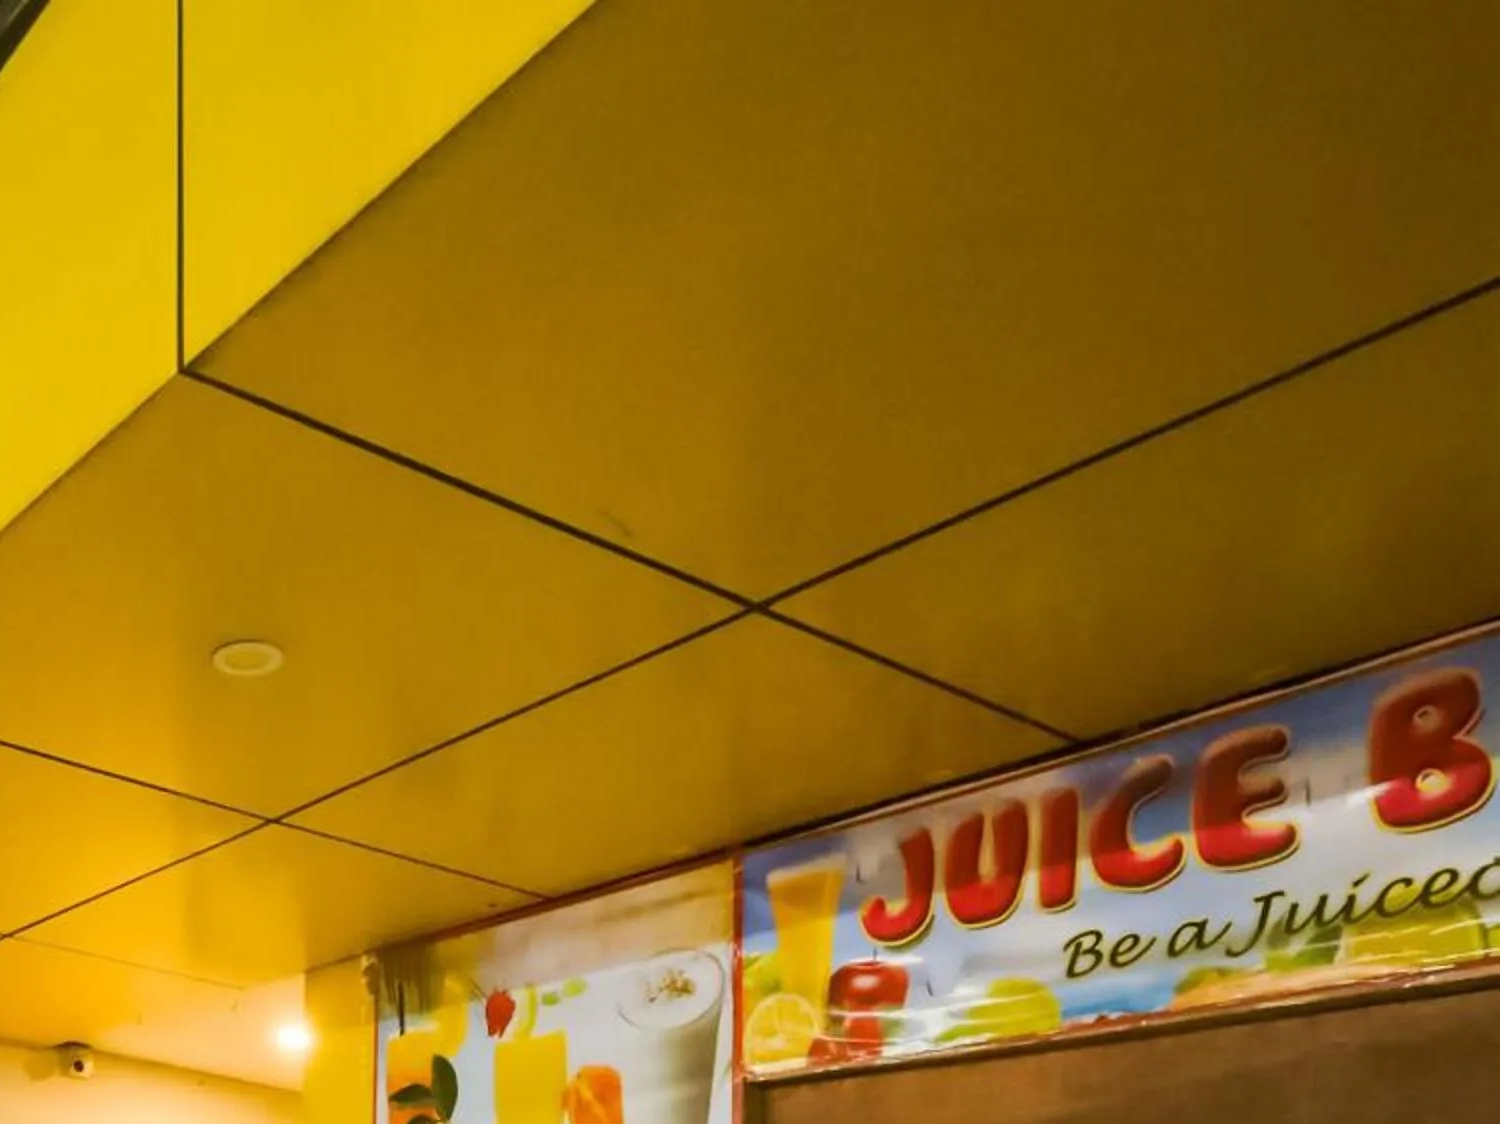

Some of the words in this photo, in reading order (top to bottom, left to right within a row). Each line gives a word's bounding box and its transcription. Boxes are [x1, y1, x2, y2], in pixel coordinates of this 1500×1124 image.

[860, 723, 1300, 947] JUICE
[1063, 930, 1155, 979] Be
[1168, 918, 1233, 954] a
